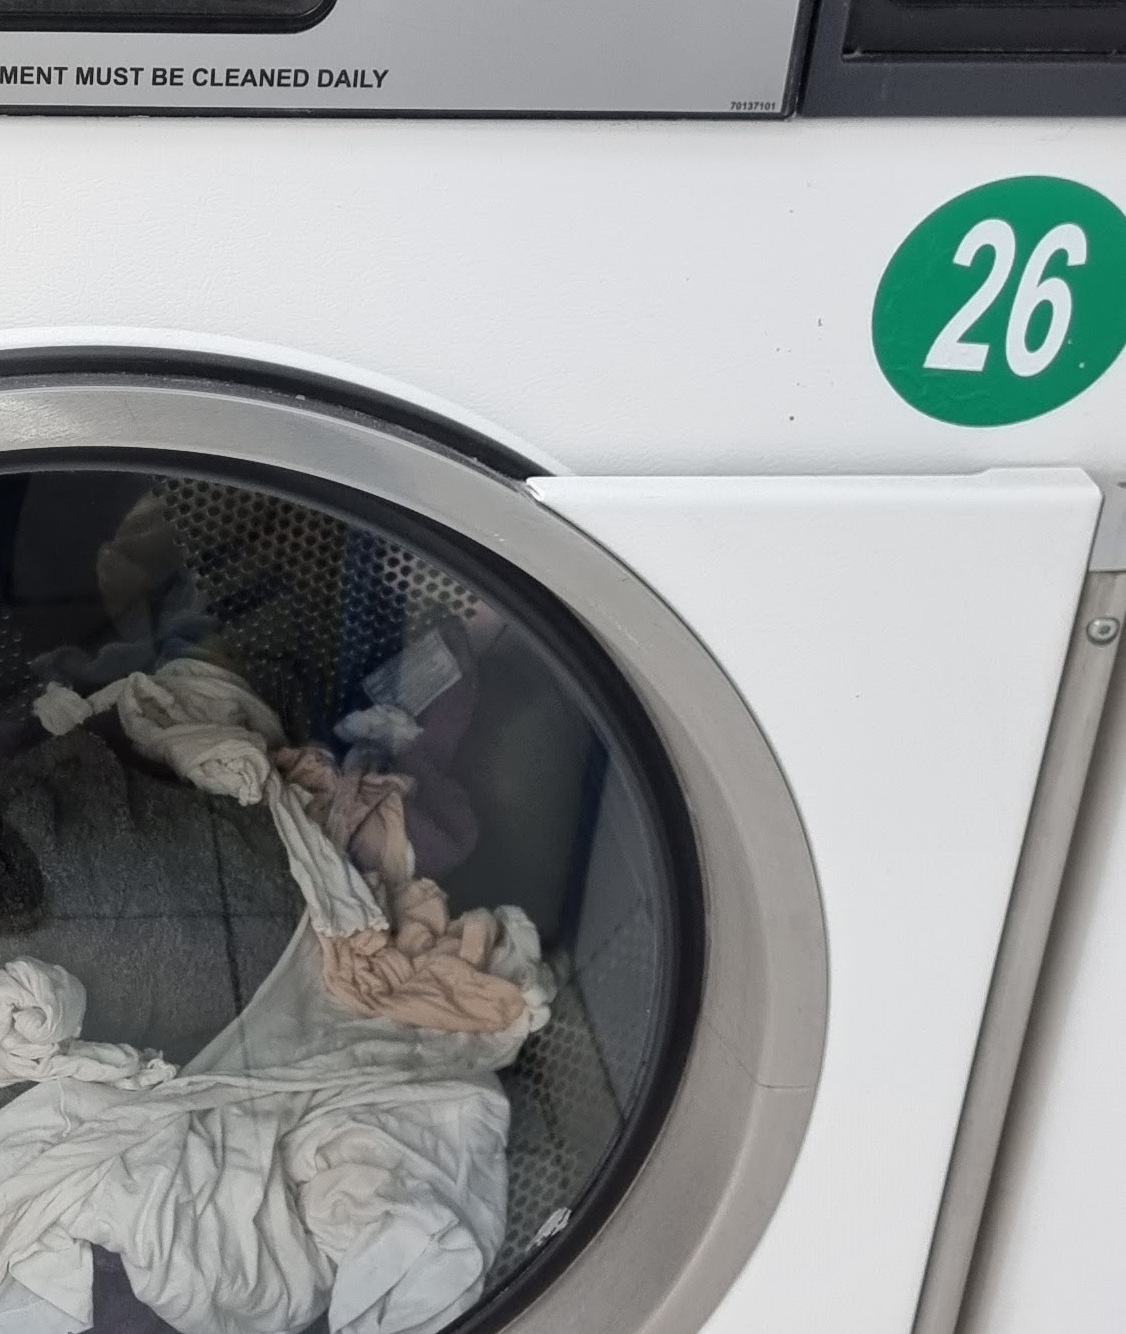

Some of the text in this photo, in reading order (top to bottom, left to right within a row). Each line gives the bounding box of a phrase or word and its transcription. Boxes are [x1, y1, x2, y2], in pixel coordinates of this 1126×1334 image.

[75, 66, 145, 86] MUST
[151, 67, 185, 87] BE
[192, 67, 310, 88] CLEANED
[317, 68, 390, 89] DAILY
[922, 218, 1088, 378] 26
